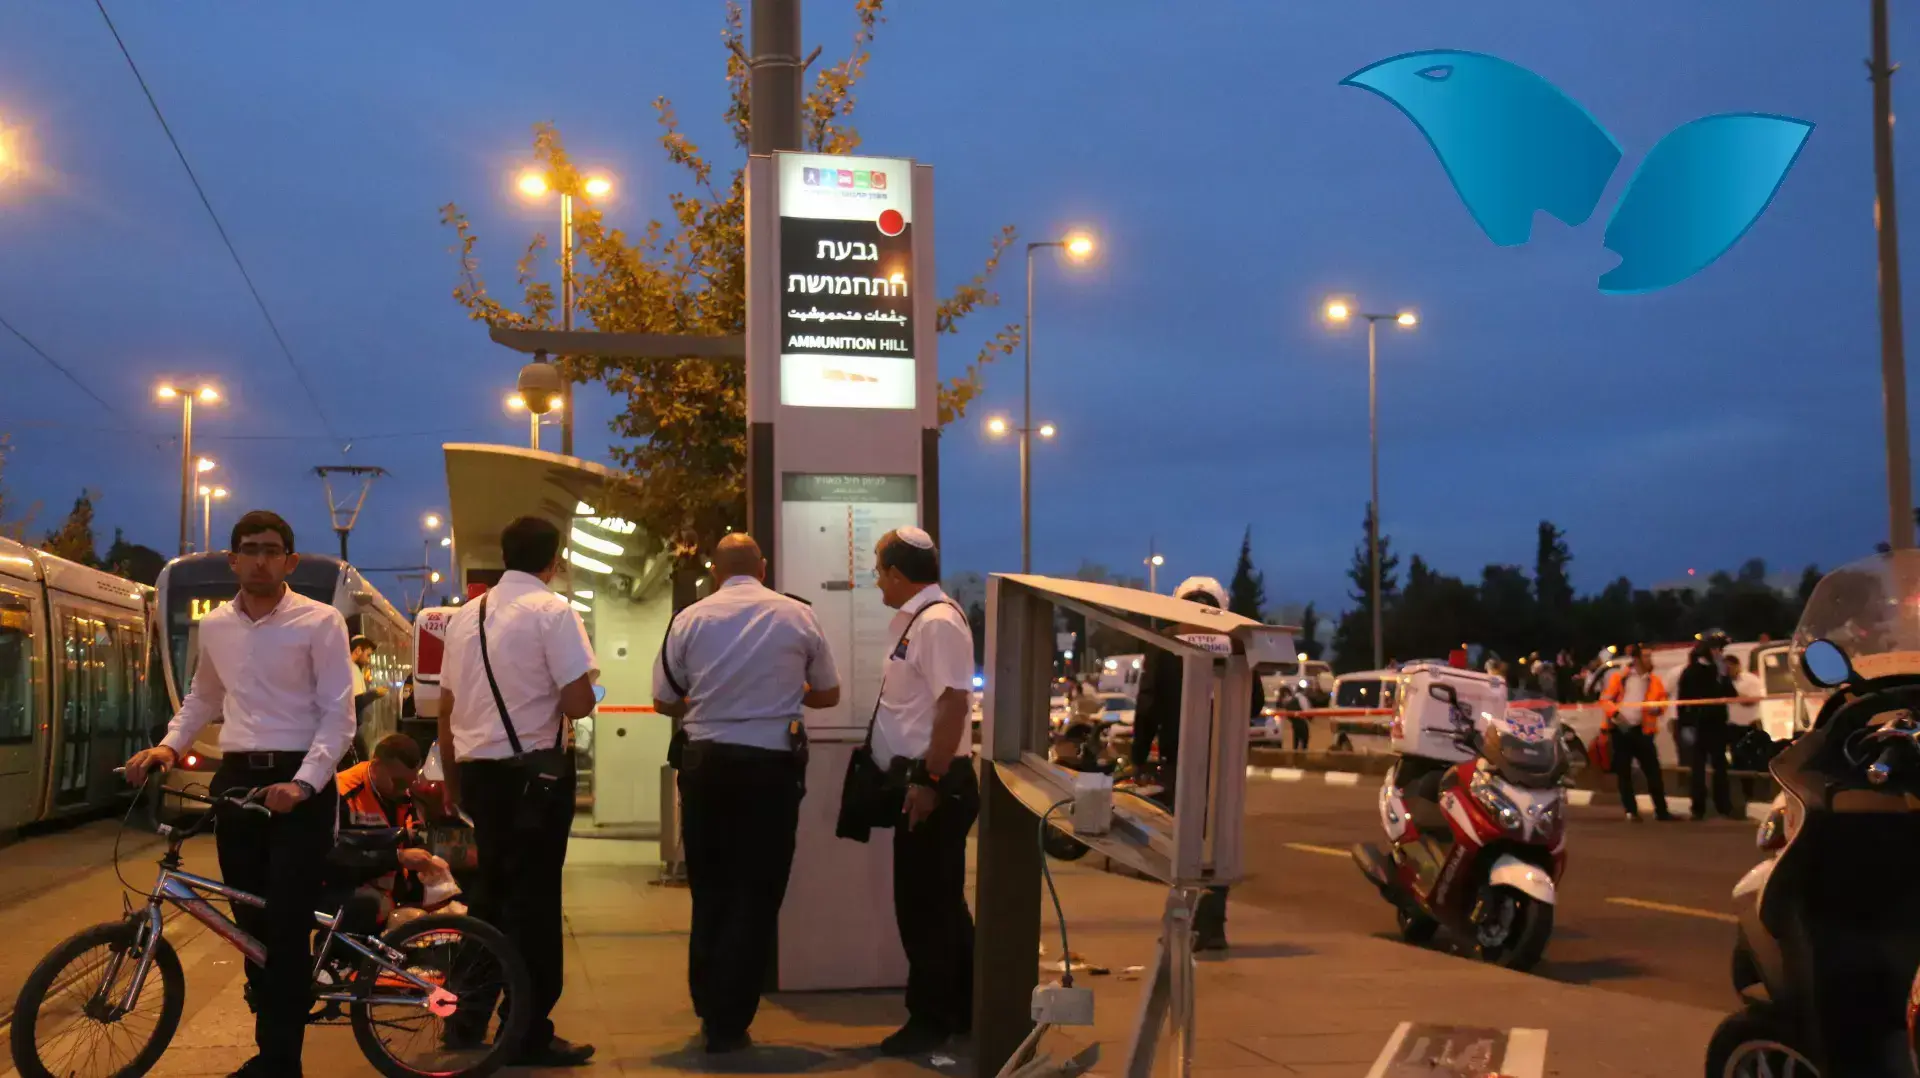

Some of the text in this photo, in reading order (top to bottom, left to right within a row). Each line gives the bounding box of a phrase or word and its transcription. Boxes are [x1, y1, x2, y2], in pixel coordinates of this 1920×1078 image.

[816, 239, 879, 261] גבעת
[787, 273, 908, 297] התחמושת
[788, 334, 909, 352] AMMUNITION HILL
